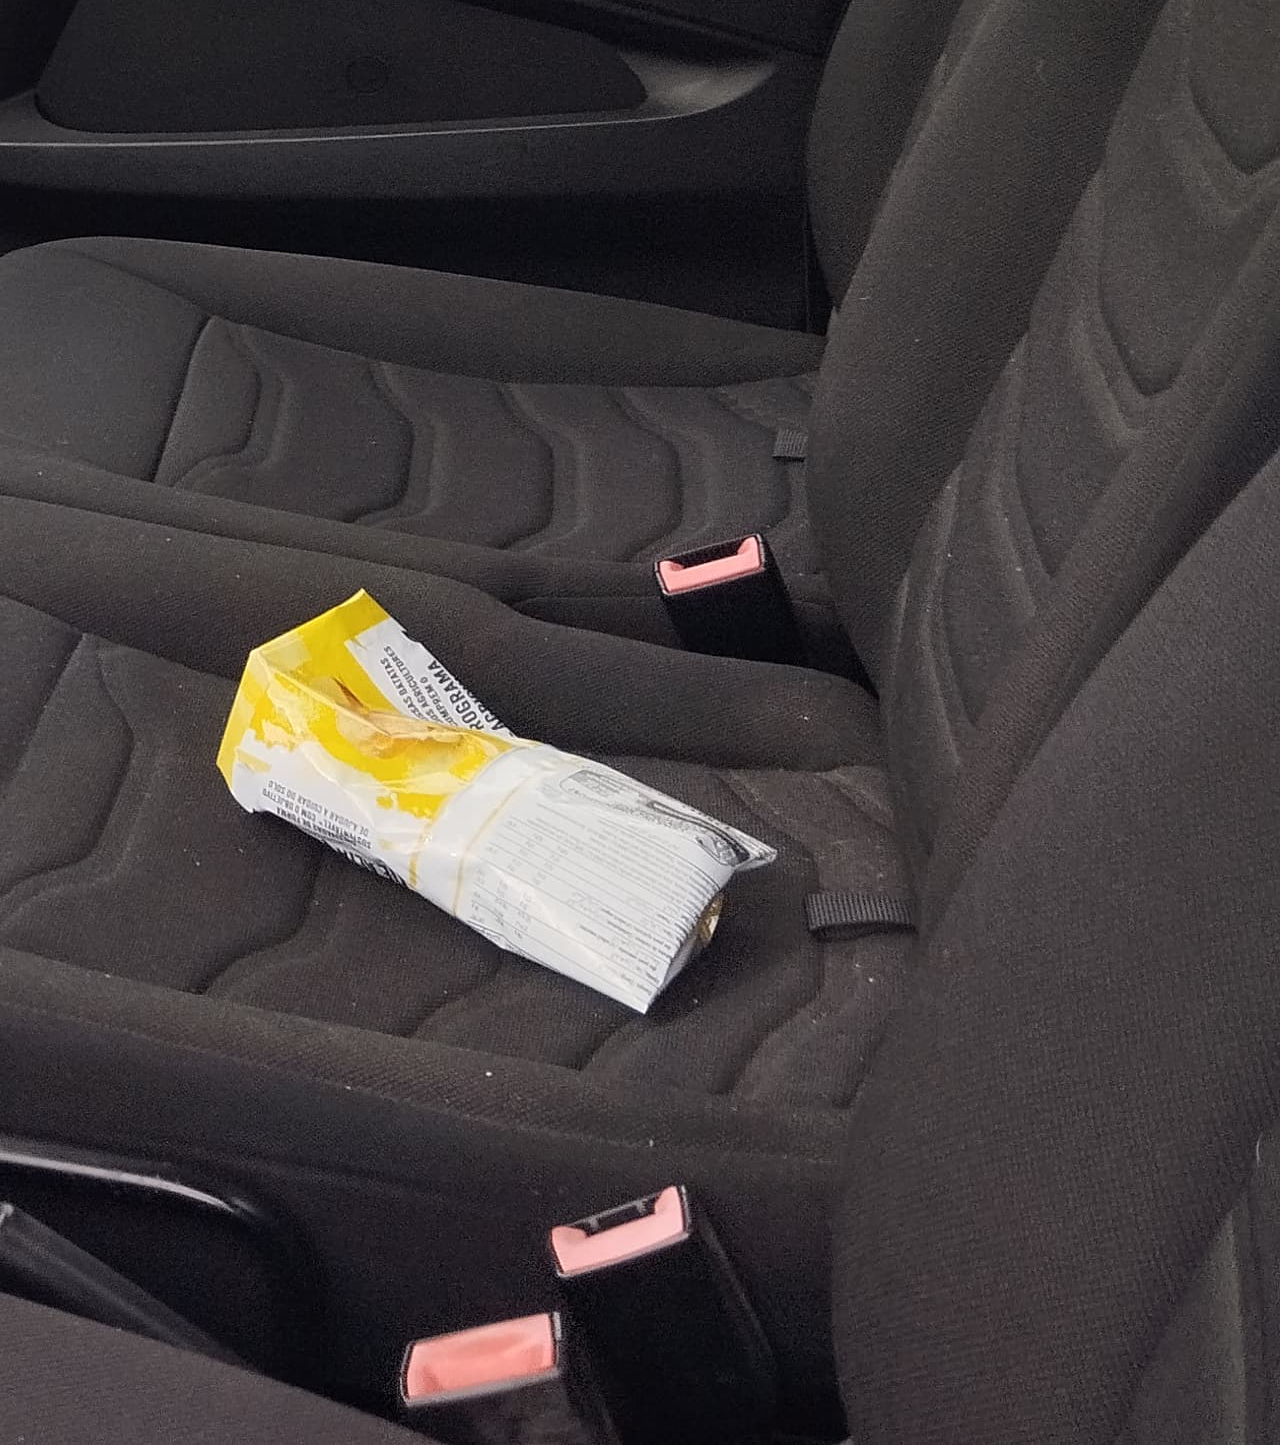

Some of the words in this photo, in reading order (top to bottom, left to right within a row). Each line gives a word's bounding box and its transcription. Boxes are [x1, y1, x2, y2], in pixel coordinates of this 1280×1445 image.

[380, 657, 407, 696] BATATAS
[383, 645, 430, 708] AGRICULTORES
[427, 659, 485, 731] ROGRAMA
[358, 825, 369, 837] DE
